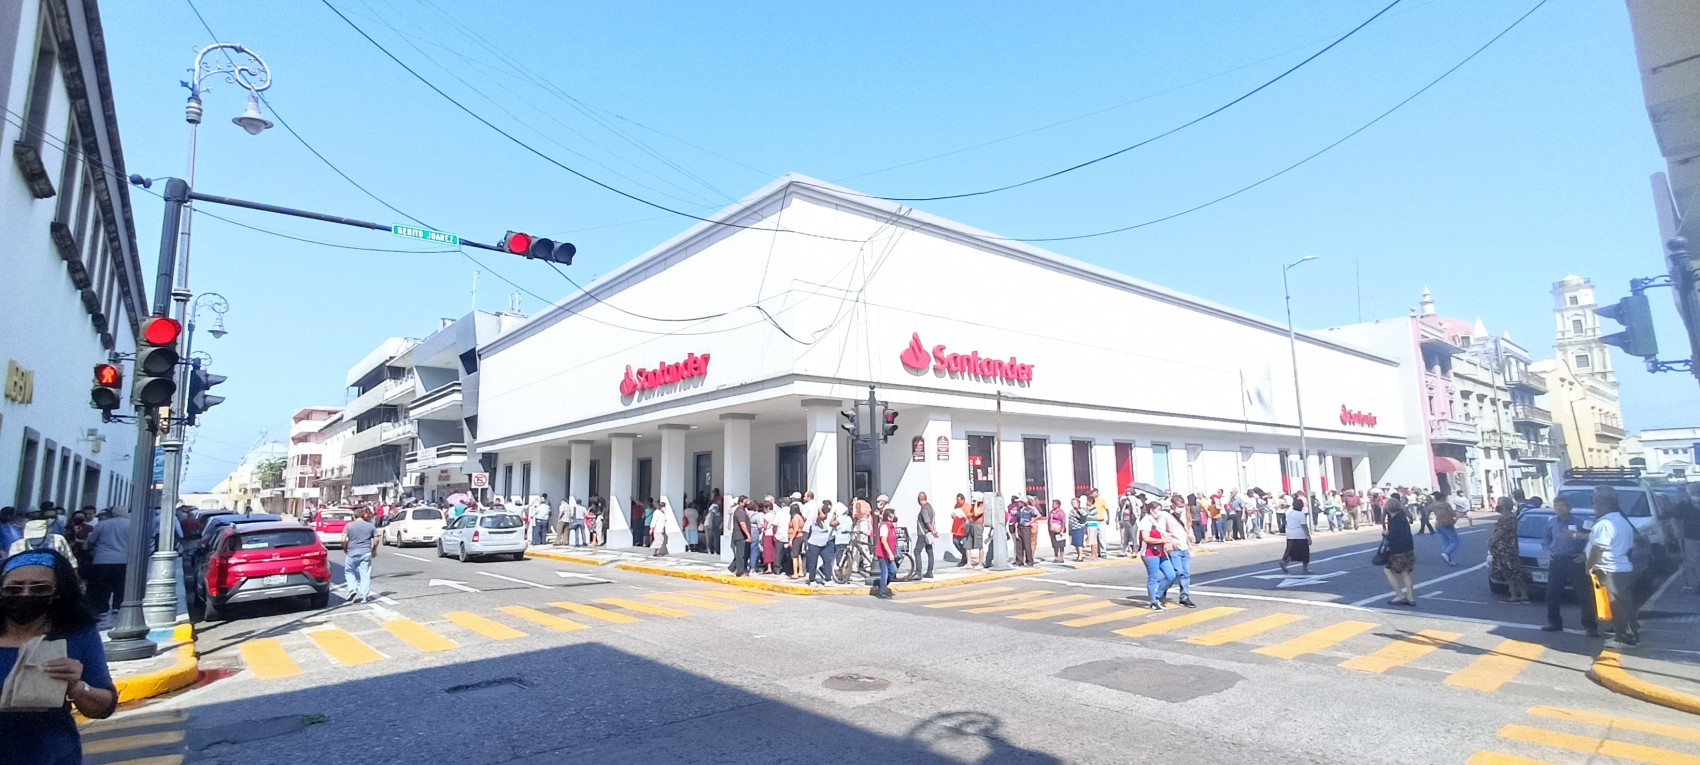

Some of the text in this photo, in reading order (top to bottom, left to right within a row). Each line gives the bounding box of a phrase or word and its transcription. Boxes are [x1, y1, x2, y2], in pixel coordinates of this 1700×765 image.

[397, 226, 424, 238] BENITO
[636, 352, 710, 391] Santander
[932, 344, 1035, 381] Santander
